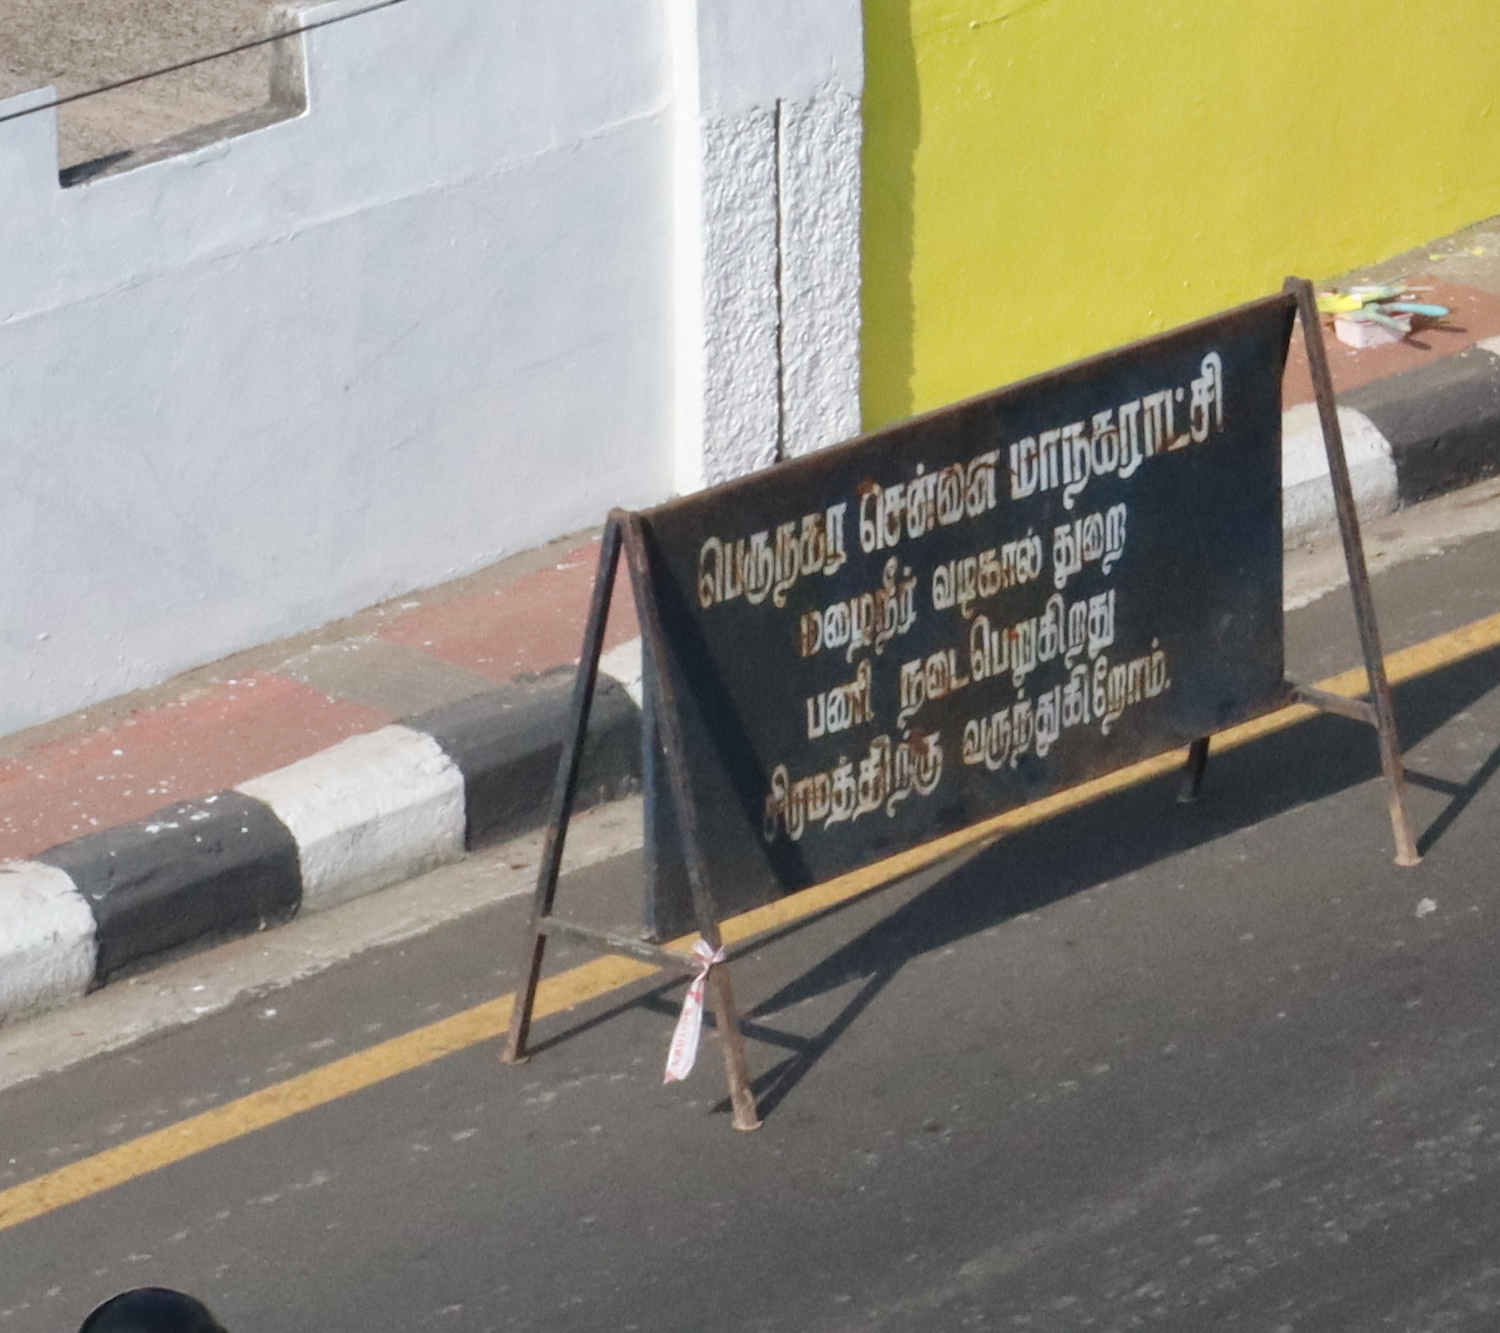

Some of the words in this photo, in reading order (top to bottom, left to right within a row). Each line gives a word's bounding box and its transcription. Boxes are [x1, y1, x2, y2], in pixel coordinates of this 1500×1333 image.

[697, 502, 848, 609] பெருநகர
[859, 462, 1000, 553] சென்னை
[1010, 351, 1224, 510] மாநகராட்சி
[801, 556, 918, 663] மழைநீர்
[1053, 502, 1127, 589] துறை
[806, 658, 875, 739] பணி
